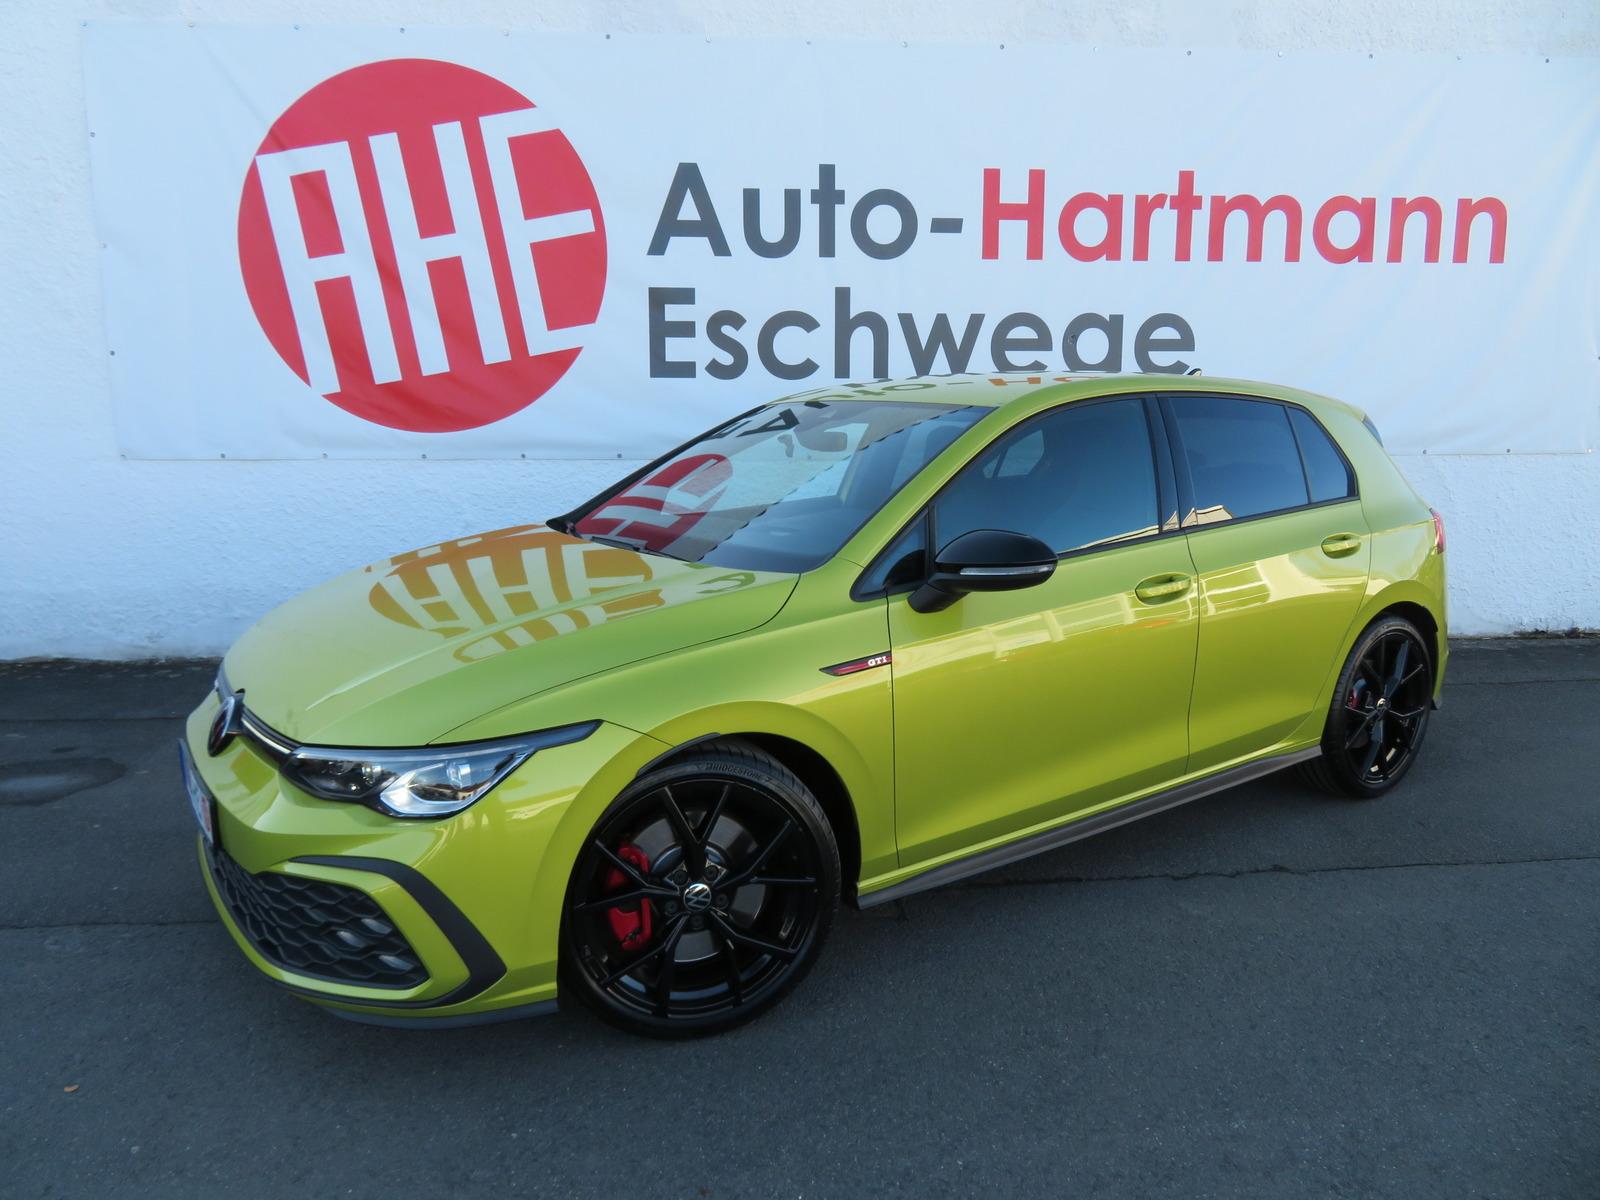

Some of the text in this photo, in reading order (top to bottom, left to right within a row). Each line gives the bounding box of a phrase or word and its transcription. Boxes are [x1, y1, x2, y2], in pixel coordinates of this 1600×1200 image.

[255, 107, 597, 396] AHE
[648, 162, 1507, 264] Auto-Hartmann
[867, 656, 888, 667] GTI
